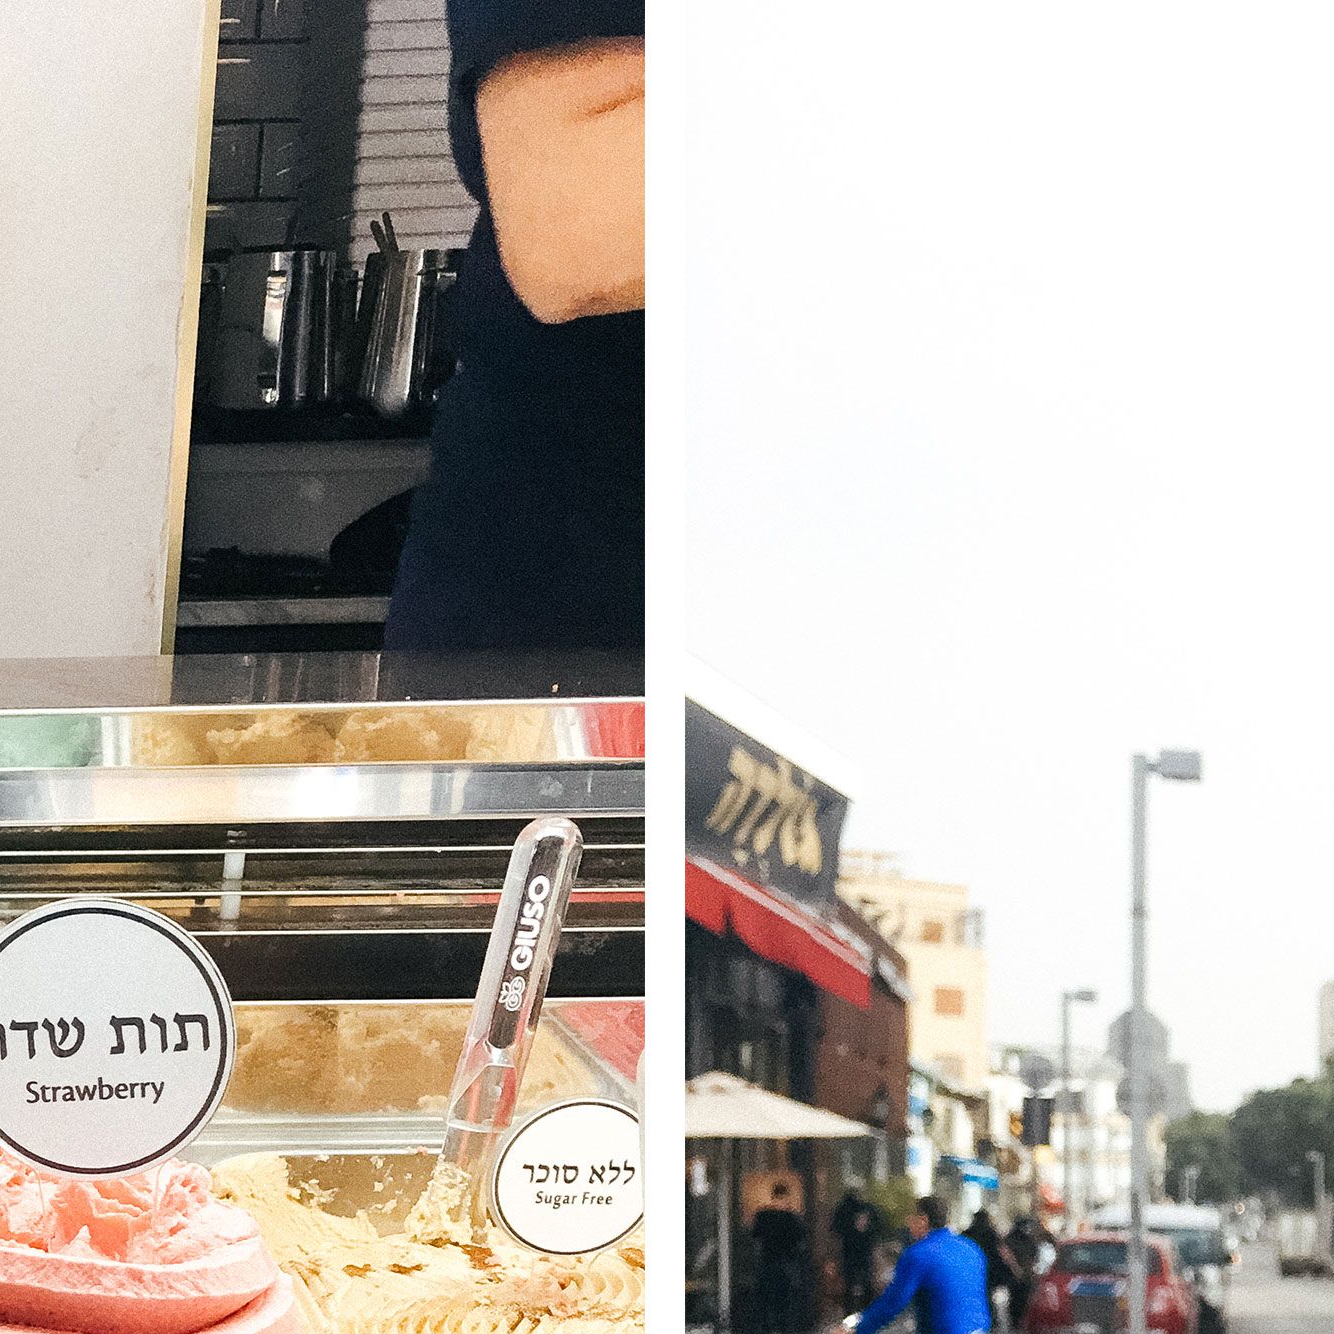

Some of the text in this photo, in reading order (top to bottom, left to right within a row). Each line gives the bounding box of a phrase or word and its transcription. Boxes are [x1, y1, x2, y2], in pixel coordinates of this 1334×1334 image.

[511, 875, 550, 971] GIUSO
[109, 1012, 211, 1056] תות
[25, 1077, 165, 1104] Strawberry
[522, 1159, 636, 1185] ללא סוכר
[535, 1190, 614, 1210] Sugar Free
